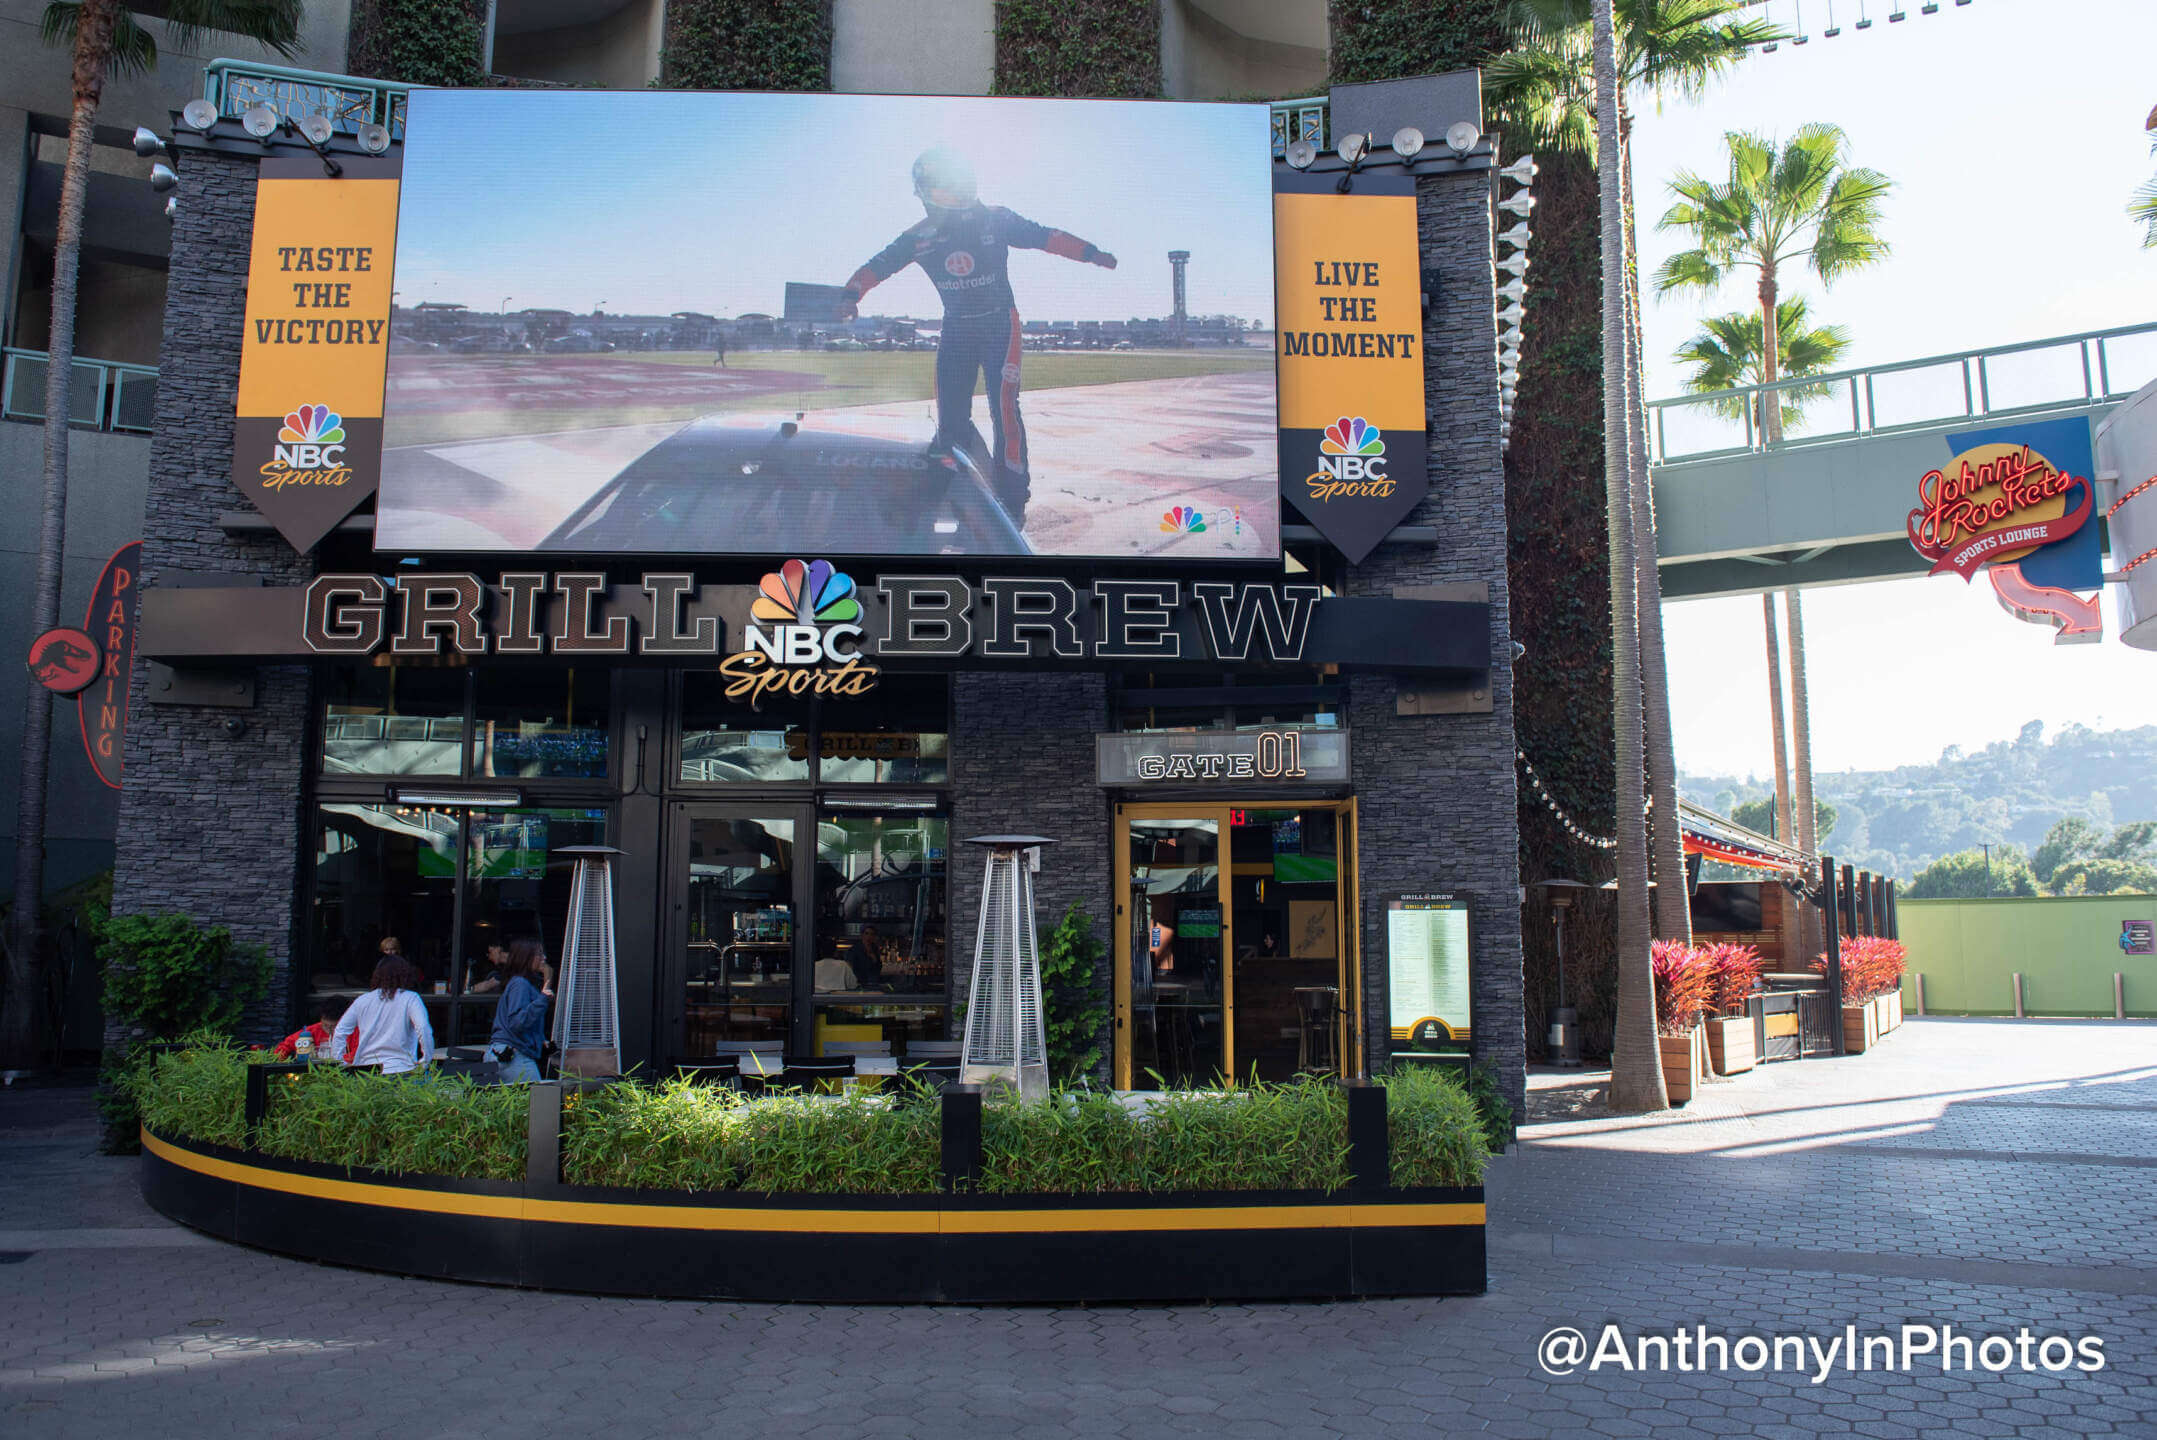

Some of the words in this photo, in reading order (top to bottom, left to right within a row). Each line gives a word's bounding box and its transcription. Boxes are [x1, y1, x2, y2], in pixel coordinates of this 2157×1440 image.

[278, 247, 372, 272] TASTE
[1314, 261, 1380, 287] LIVE
[293, 283, 351, 308] THE
[1320, 297, 1377, 322] THE
[255, 319, 385, 345] VICTORY
[1283, 332, 1415, 359] MOMENT
[273, 445, 346, 469] NBC
[1318, 456, 1388, 480] NBC
[260, 460, 352, 492] Sports
[1306, 471, 1396, 503] Sports
[1918, 444, 2044, 547] Johnny
[1940, 467, 2073, 547] Rockets
[1953, 536, 1999, 567] SPORTS
[1999, 525, 2049, 546] LOUNGE
[302, 571, 720, 656] GRILL
[877, 574, 1321, 660] BREW
[743, 623, 864, 664] NBC
[97, 567, 131, 758] PARKING
[719, 651, 878, 706] Sports
[1138, 754, 1254, 779] GATE
[1257, 731, 1306, 777] 01
